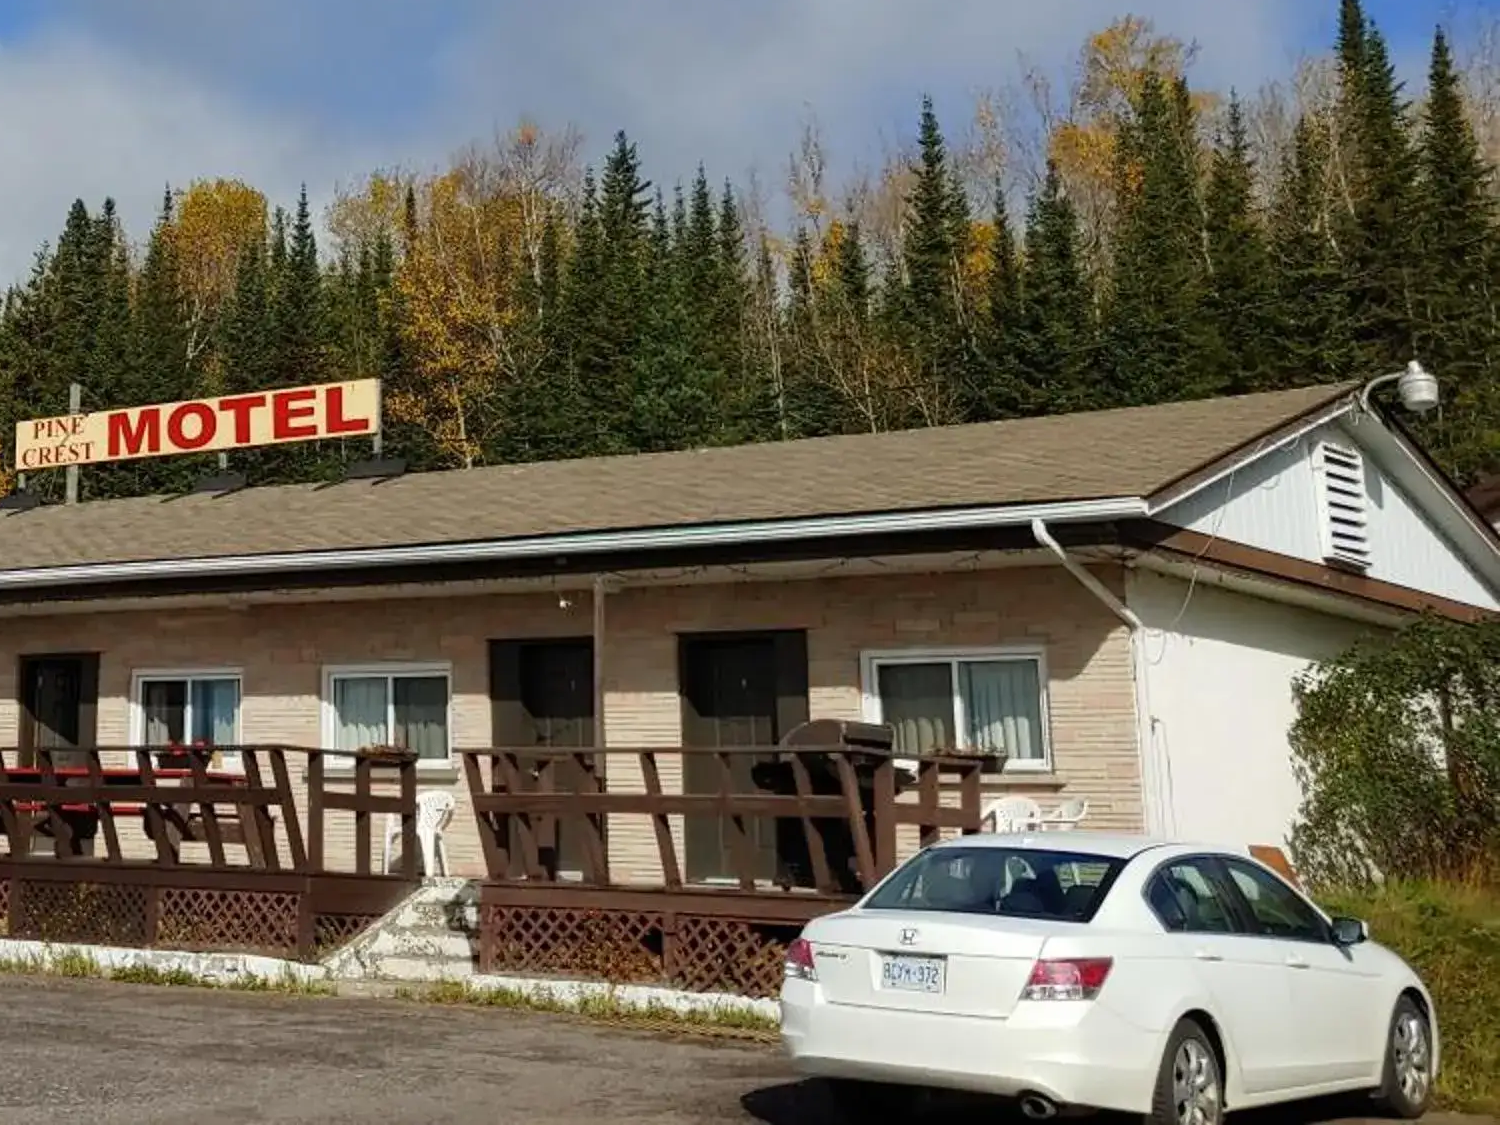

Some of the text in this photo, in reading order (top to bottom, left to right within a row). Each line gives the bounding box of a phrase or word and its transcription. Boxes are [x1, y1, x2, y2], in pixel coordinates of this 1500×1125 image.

[33, 416, 85, 439] PINE
[108, 386, 369, 457] MOTEL
[22, 441, 95, 467] CREST
